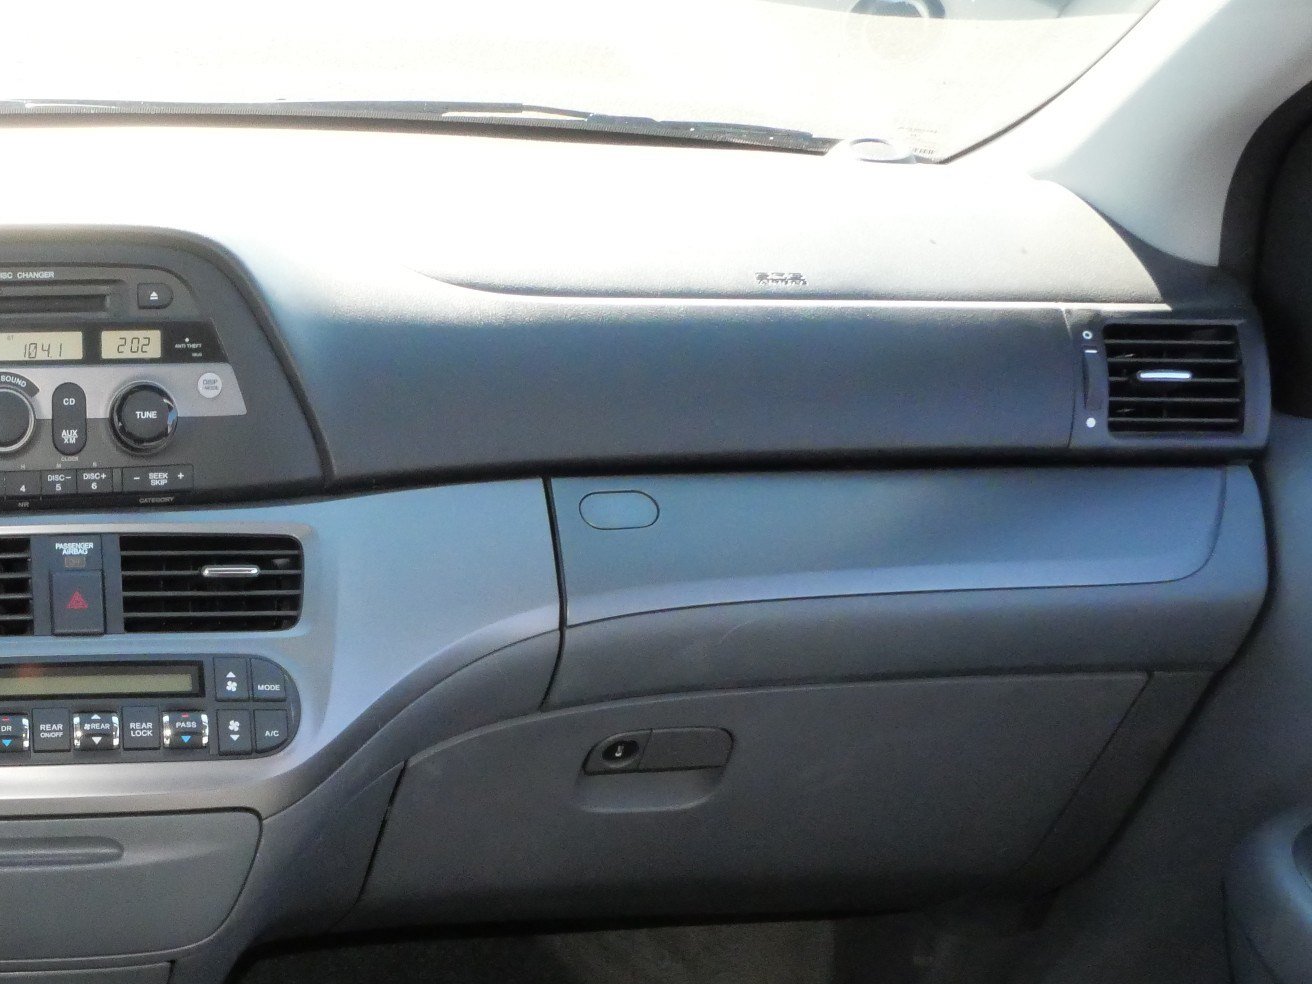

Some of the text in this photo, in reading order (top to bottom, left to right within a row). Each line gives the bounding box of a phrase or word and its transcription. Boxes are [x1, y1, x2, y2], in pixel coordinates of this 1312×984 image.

[17, 271, 55, 279] CHANGER
[116, 336, 150, 354] 202
[23, 342, 63, 358] 104.1
[0, 375, 27, 388] SOUND
[63, 398, 76, 406] CD
[61, 430, 78, 438] AUX
[63, 436, 76, 444] XM
[148, 472, 168, 480] SEEK
[20, 484, 26, 492] 4
[91, 482, 98, 490] 6
[55, 542, 94, 550] PASSENGER
[62, 548, 88, 556] AIRBAG
[130, 722, 153, 730] REAR
